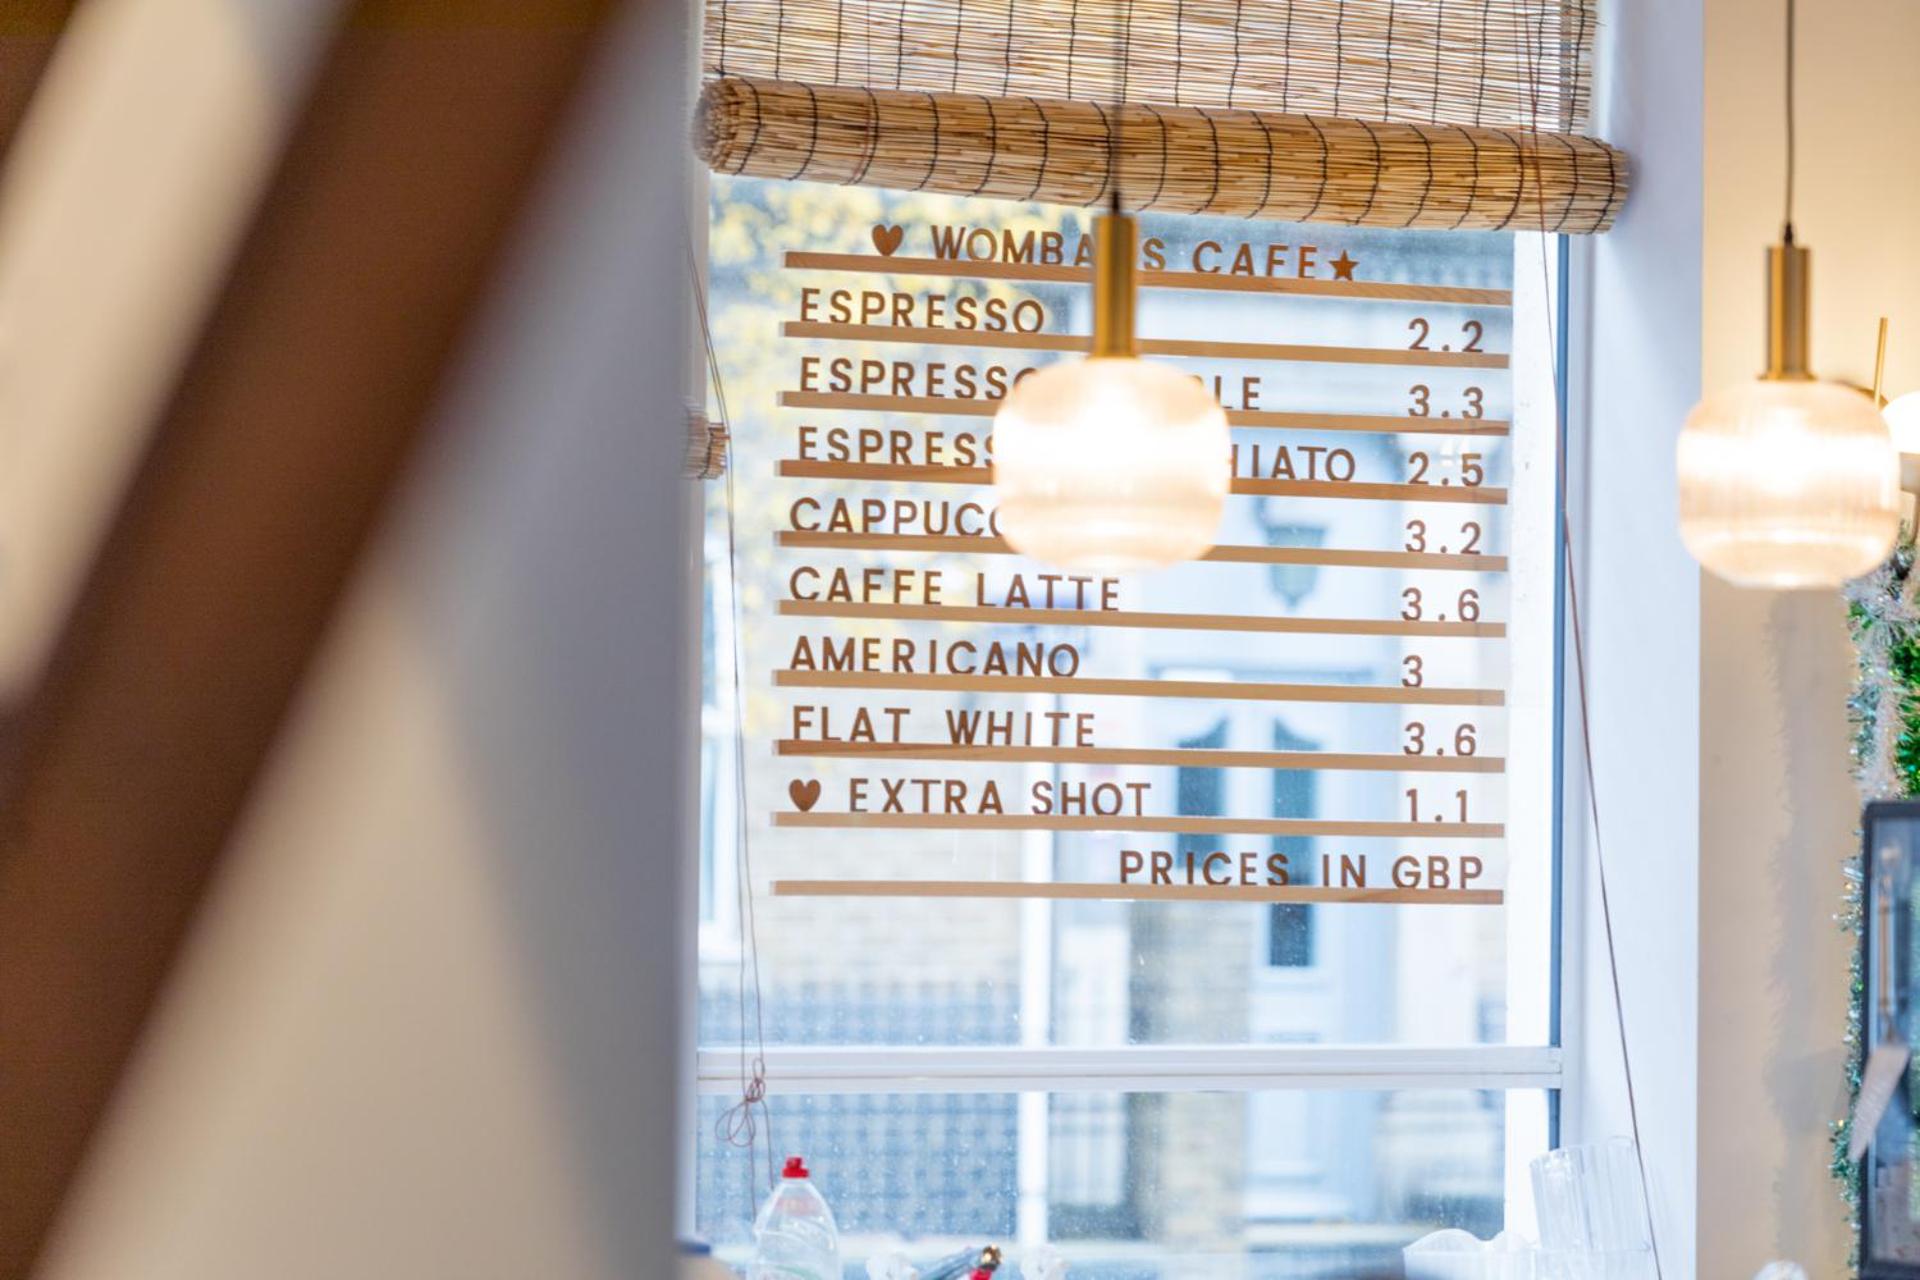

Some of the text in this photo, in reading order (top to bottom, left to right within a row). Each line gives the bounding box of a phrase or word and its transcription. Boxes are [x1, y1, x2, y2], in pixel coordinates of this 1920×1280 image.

[931, 225, 1317, 278] WOMBAS CAFE
[801, 288, 1044, 333] ESPRESSO
[1408, 318, 1484, 353] 2.2
[801, 357, 1037, 399] ESPRESS
[1408, 385, 1484, 419] 3.3
[798, 426, 995, 467] ESPRES
[1408, 452, 1484, 487] 2.5
[789, 497, 1003, 537] CAPPUC
[1405, 520, 1481, 555] 3.2
[789, 567, 1120, 611] CAFFE LATTE
[1401, 588, 1480, 622] 3.6
[790, 636, 1080, 677] AMERICANO
[1402, 655, 1423, 688] 3
[793, 706, 1095, 747] FLAT WHITE
[1403, 722, 1477, 757] 3.6
[850, 778, 1151, 817] EXTRA SHOT
[1406, 789, 1468, 822] 1.1
[1120, 850, 1483, 889] PRICES IN GBP
